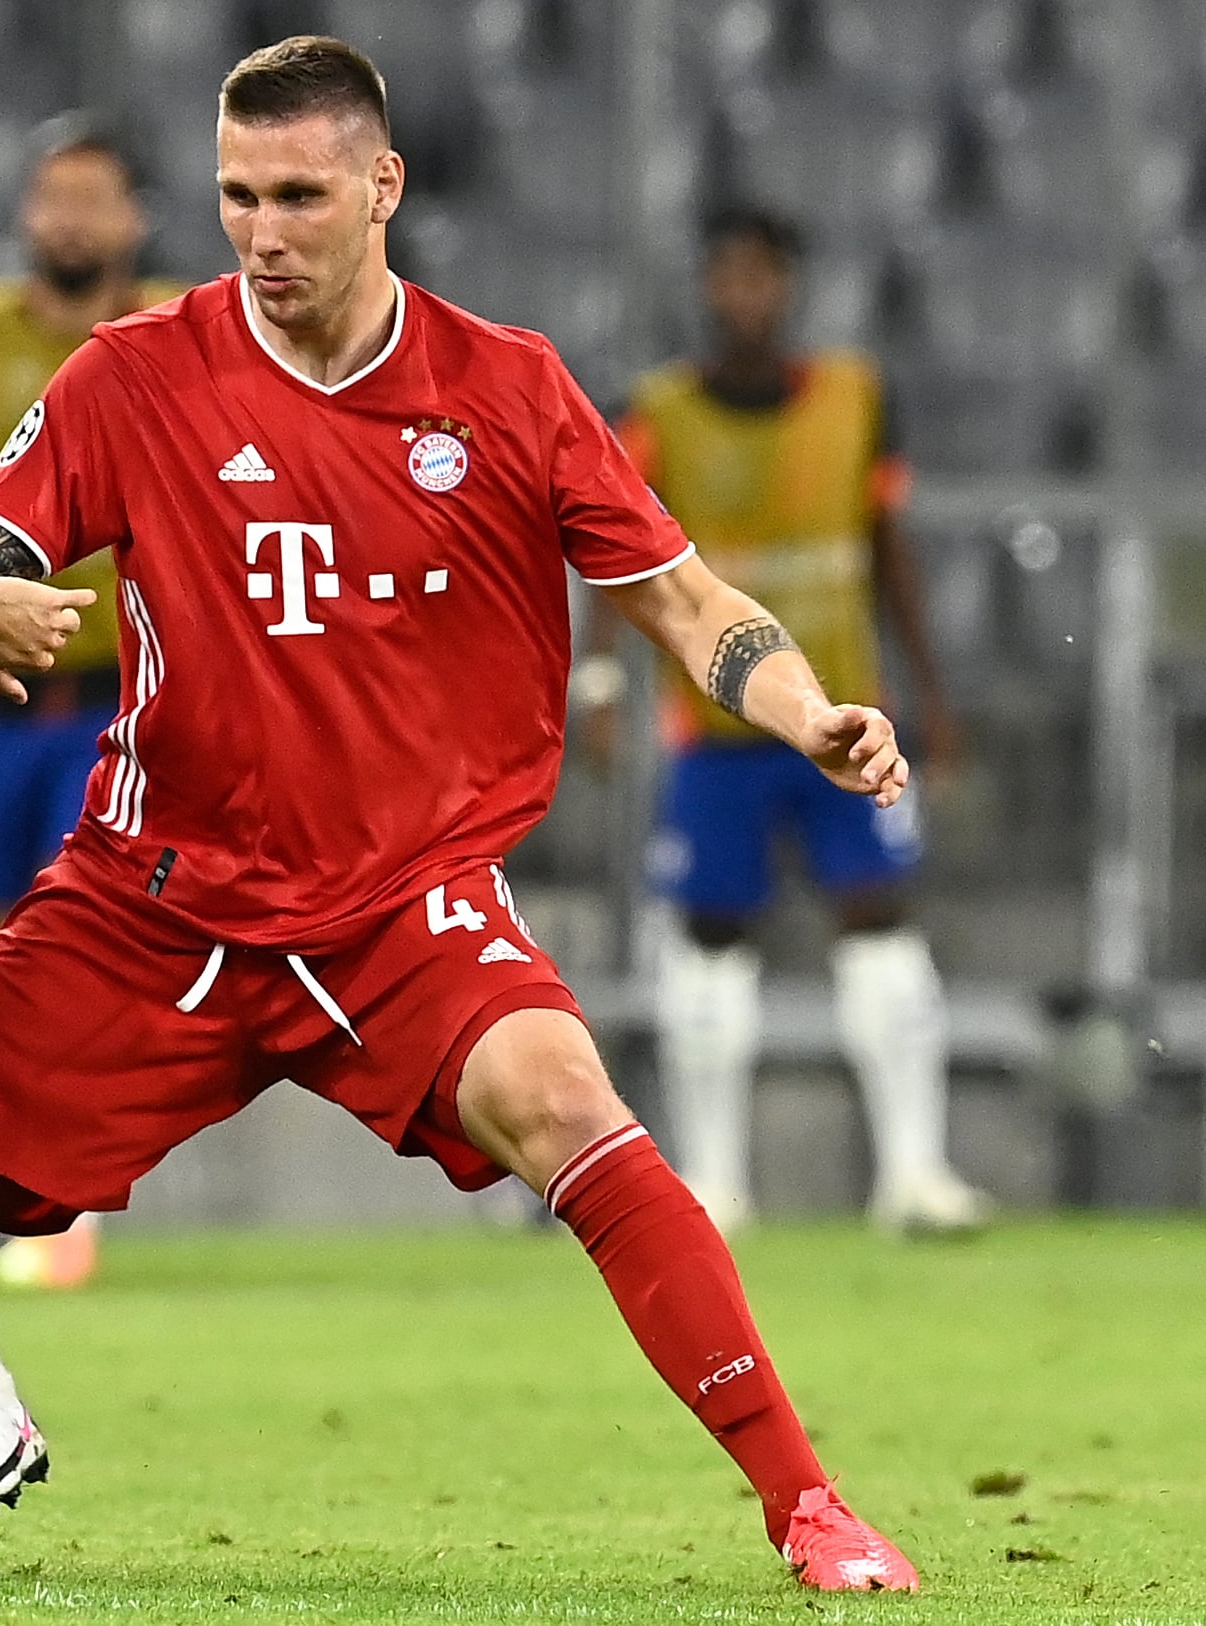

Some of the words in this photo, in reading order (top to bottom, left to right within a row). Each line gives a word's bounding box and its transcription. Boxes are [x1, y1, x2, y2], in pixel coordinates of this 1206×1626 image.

[218, 466, 276, 482] adidas
[426, 884, 488, 936] 4
[698, 1354, 756, 1395] FCB
